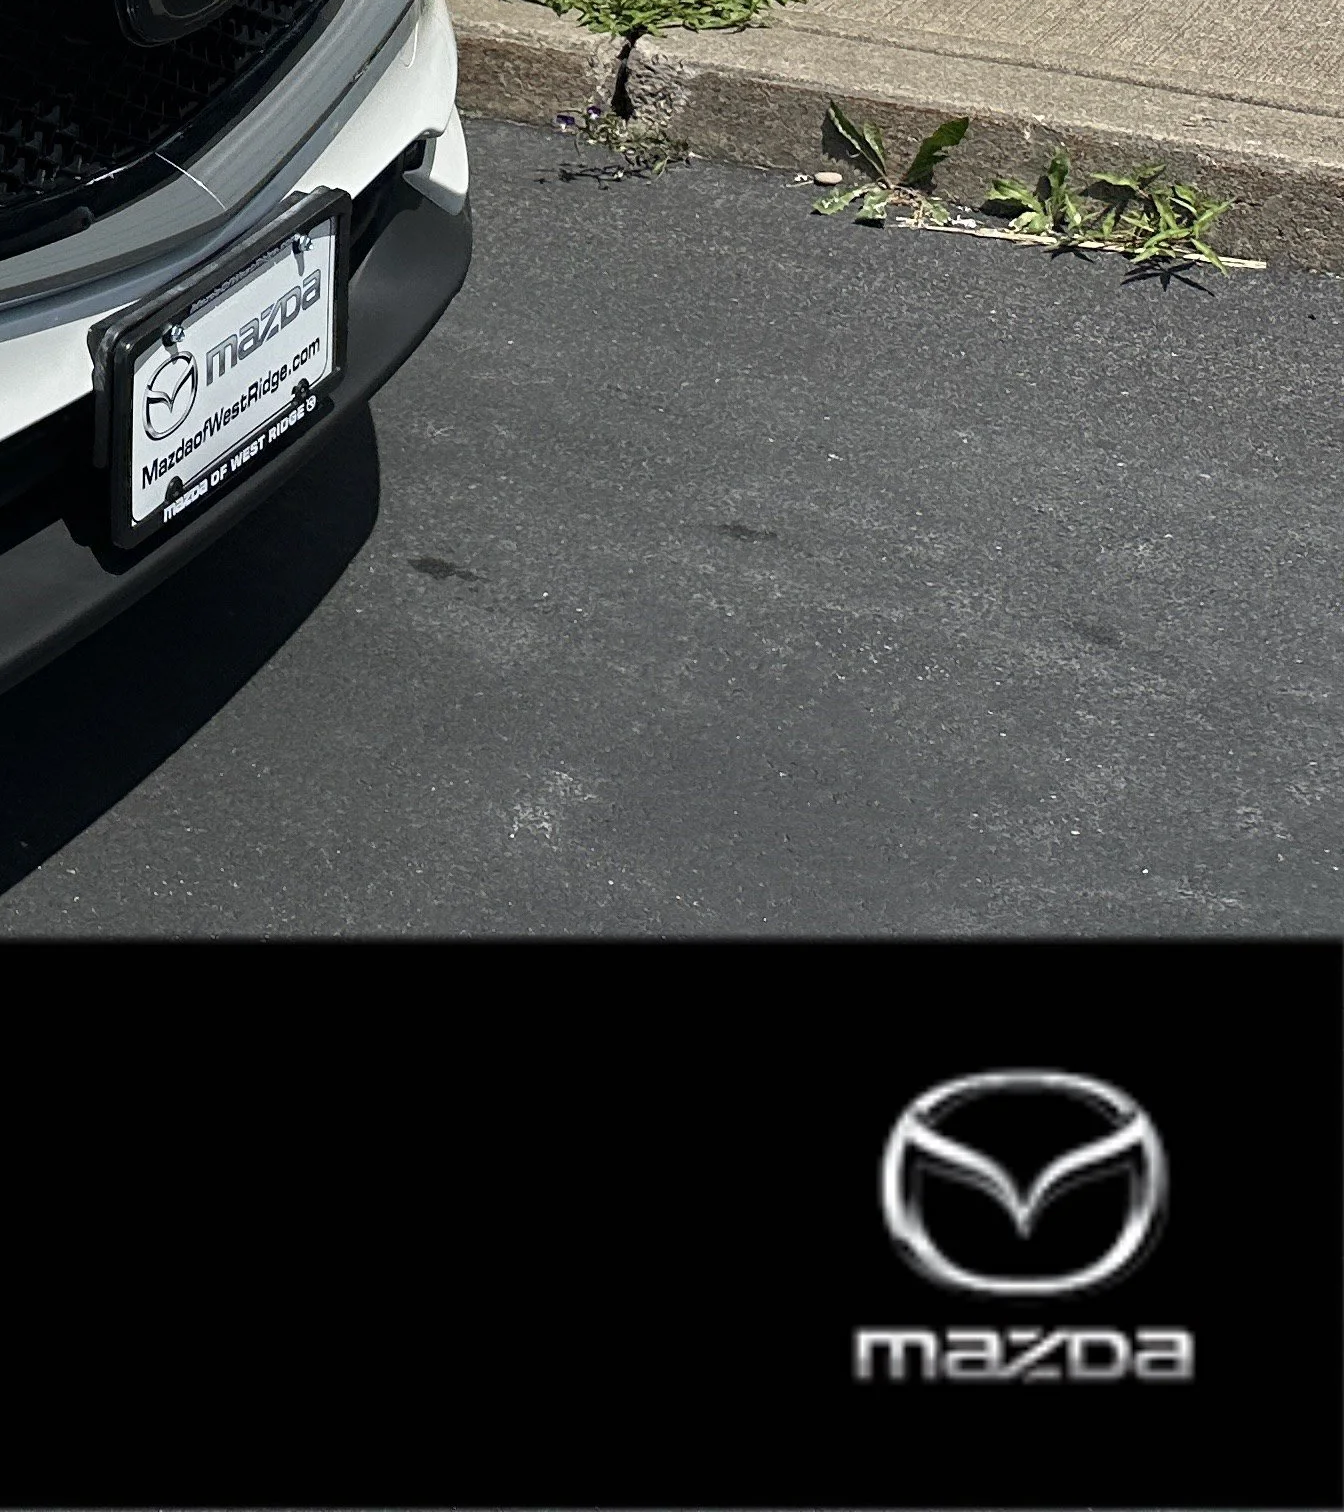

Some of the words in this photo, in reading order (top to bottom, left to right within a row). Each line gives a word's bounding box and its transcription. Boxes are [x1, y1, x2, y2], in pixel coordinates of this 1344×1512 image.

[141, 336, 321, 490] MazdaofWestRidge.com
[210, 463, 229, 487] OF
[230, 434, 266, 472] WEST
[268, 402, 306, 444] RIDGE
